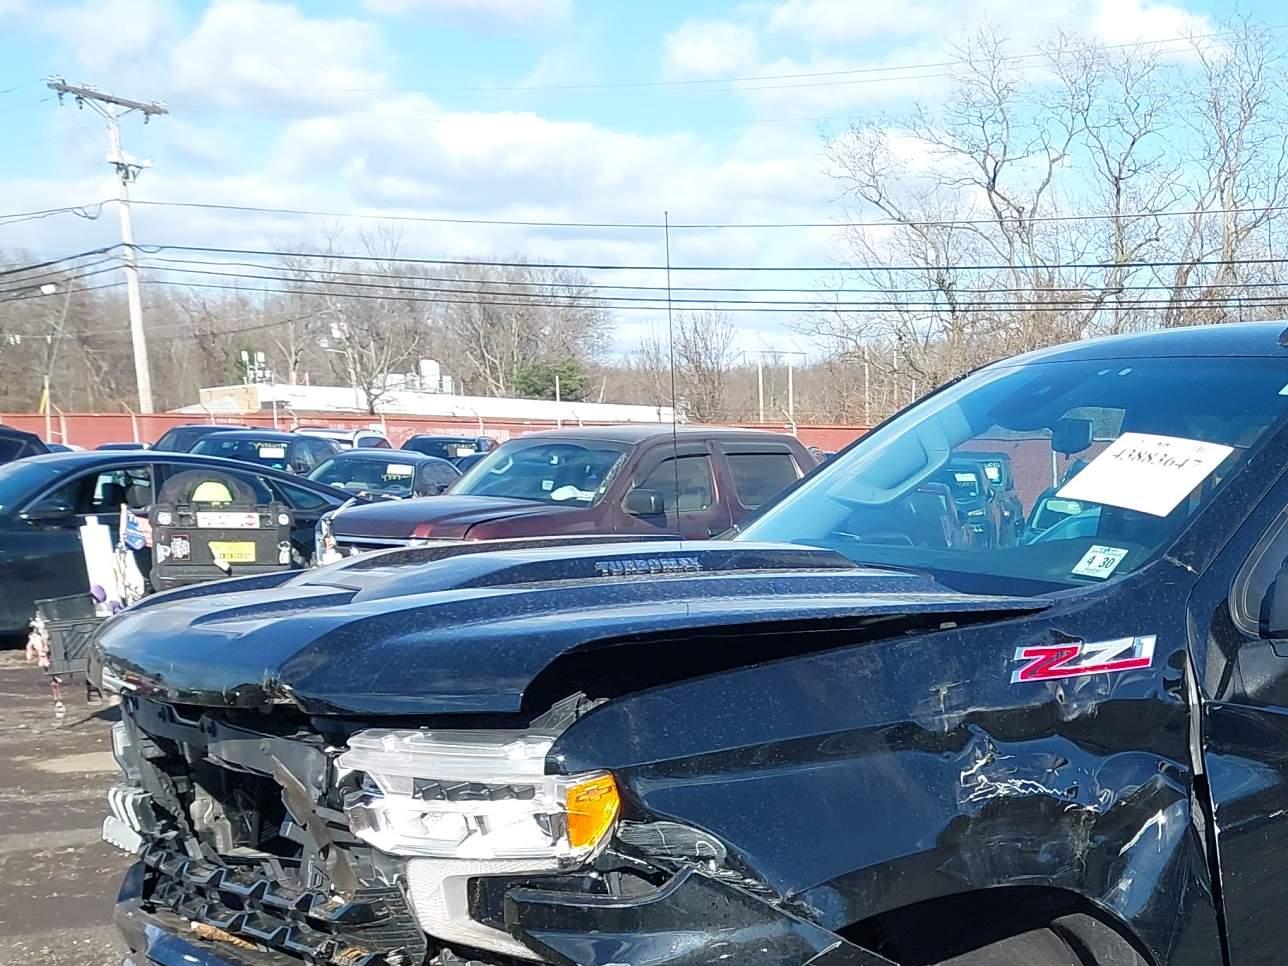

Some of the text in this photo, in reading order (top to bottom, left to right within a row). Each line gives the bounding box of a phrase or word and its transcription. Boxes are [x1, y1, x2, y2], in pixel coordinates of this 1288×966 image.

[1087, 555, 1116, 569] 4 30
[1010, 634, 1157, 684] Z71
